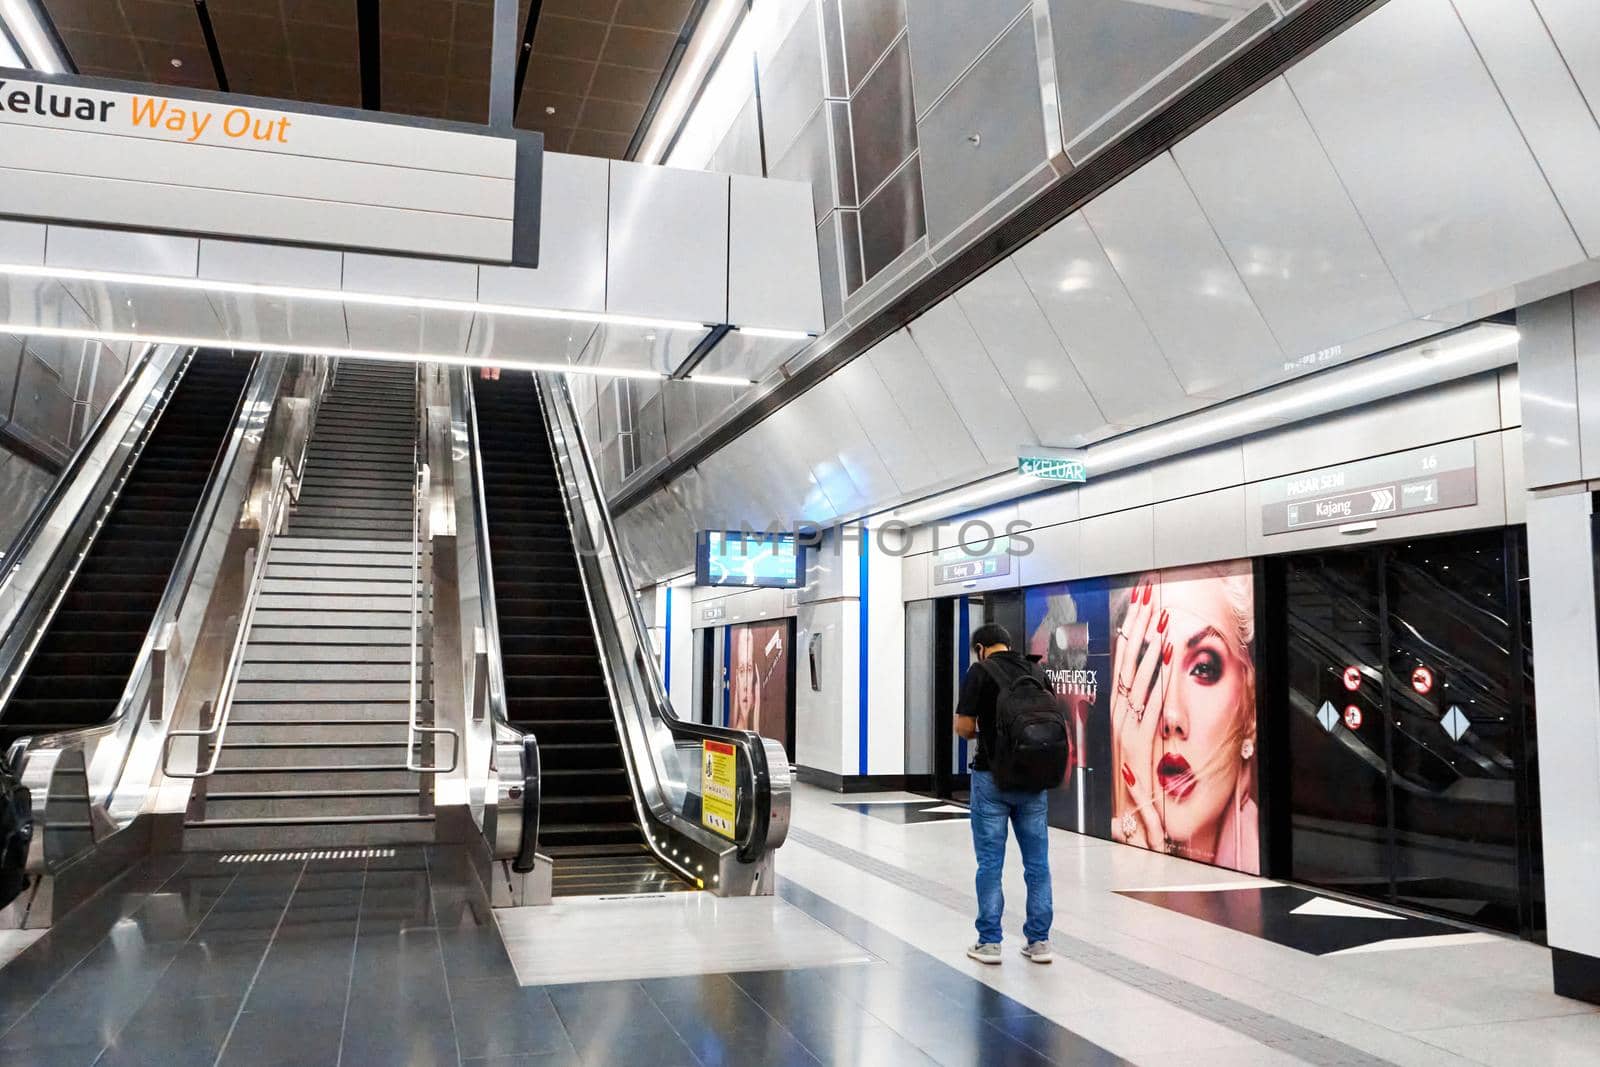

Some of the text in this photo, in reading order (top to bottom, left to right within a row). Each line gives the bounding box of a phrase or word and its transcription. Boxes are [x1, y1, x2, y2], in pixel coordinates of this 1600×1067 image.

[131, 95, 212, 142] Way
[223, 108, 292, 143] Out
[1032, 460, 1084, 481] KELUAR
[1421, 455, 1437, 470] 16
[1287, 478, 1320, 496] PASAR
[1423, 483, 1433, 502] 1
[1316, 500, 1352, 517] Kajang
